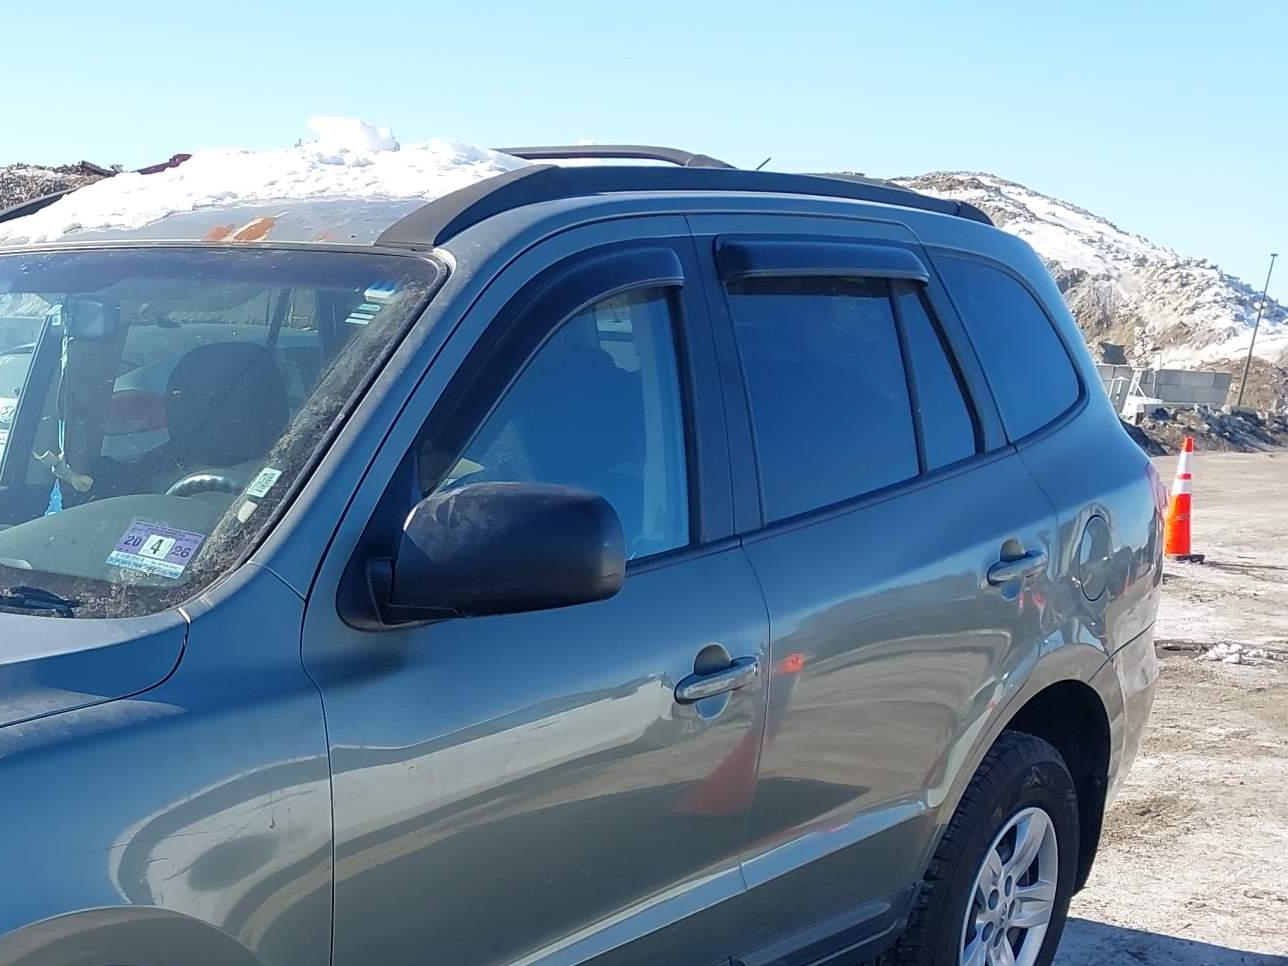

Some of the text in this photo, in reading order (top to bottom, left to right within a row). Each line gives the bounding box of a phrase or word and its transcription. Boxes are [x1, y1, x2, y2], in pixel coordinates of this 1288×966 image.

[124, 535, 192, 558] 20 4 26
